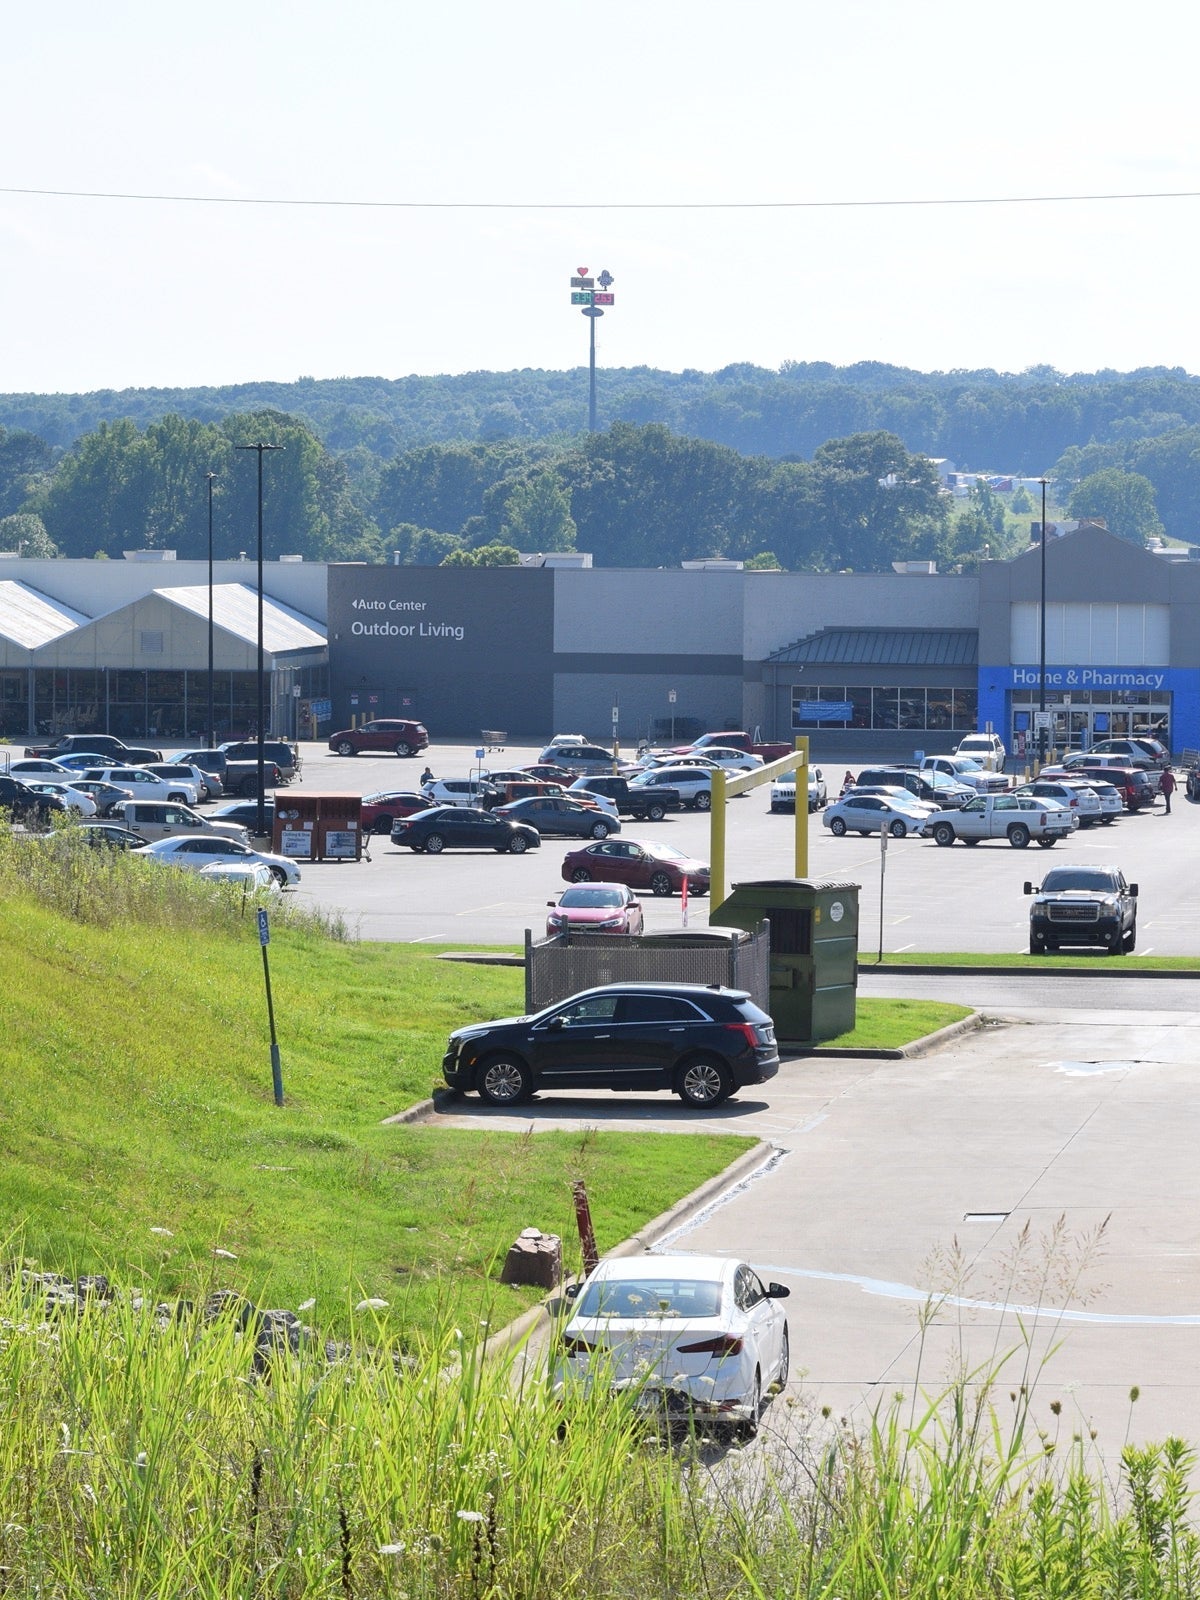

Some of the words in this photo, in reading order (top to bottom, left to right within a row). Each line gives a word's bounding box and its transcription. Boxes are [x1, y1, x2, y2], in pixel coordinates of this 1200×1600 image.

[358, 599, 386, 610] Auto
[388, 600, 427, 611] Center
[351, 622, 416, 636] Outdoor
[419, 622, 464, 640] Living
[1066, 670, 1078, 684] &
[1082, 670, 1164, 689] Pharmacy
